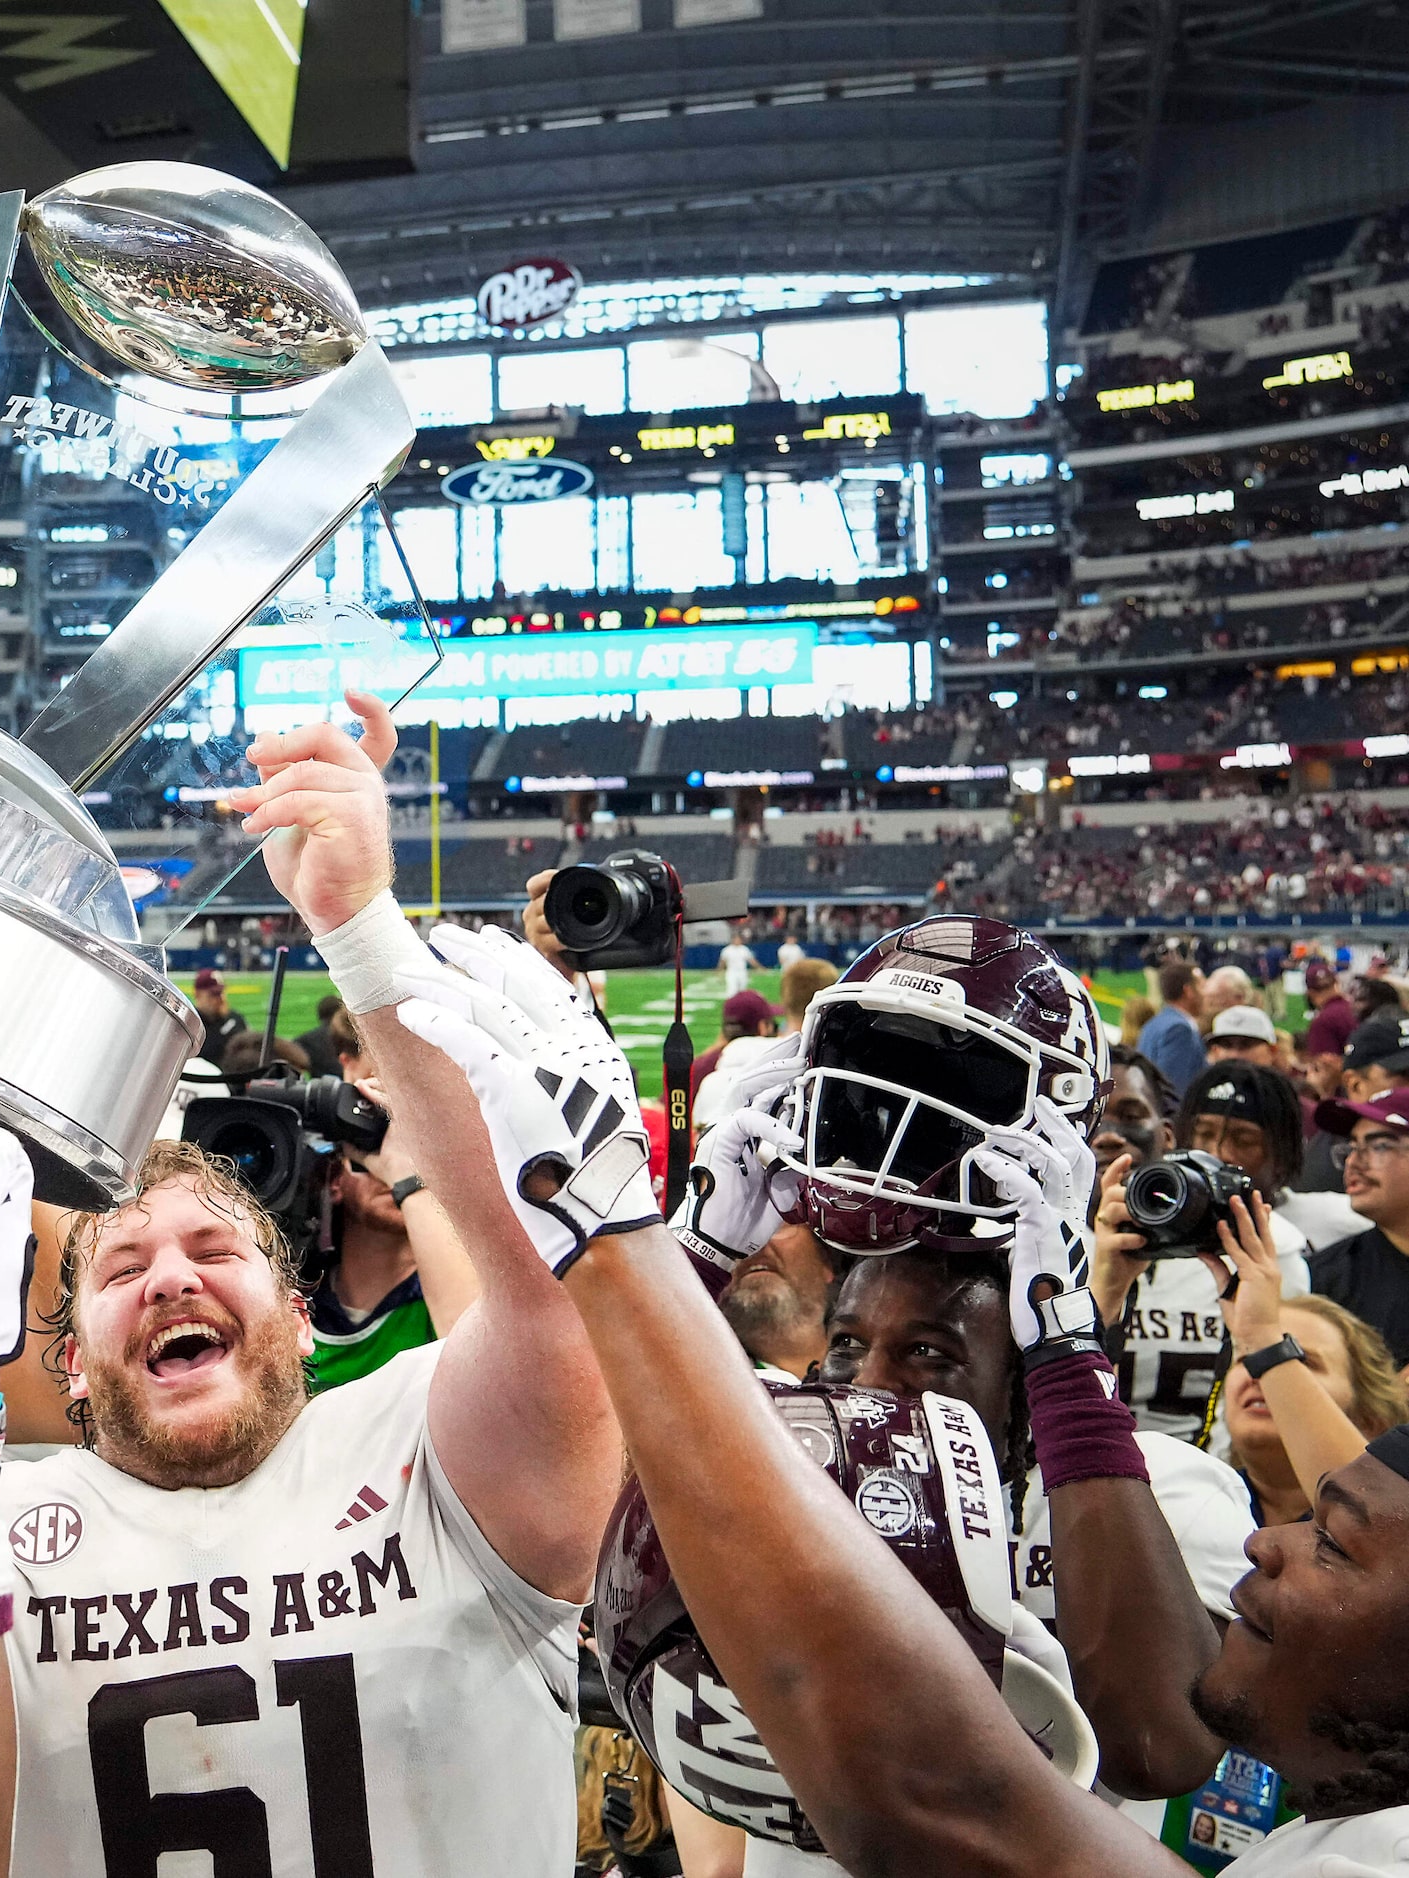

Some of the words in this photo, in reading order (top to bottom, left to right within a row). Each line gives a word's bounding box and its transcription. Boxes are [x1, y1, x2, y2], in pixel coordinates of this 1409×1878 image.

[514, 264, 555, 290] Dr
[471, 466, 565, 501] Ford
[492, 650, 599, 681] POWERED
[604, 649, 633, 678] BY
[636, 641, 733, 678] AT&T
[733, 638, 798, 675] 5G
[889, 972, 944, 996] AGGIES
[671, 1088, 687, 1130] EOS
[700, 1246, 716, 1260] GIG
[936, 1401, 973, 1438] A&M
[892, 1434, 929, 1473] 24
[862, 1481, 910, 1532] SEC
[949, 1439, 992, 1540] TEXAS
[10, 1504, 82, 1565] SEC
[27, 1576, 250, 1663] TEXAS
[271, 1532, 417, 1637] A&M
[88, 1653, 376, 1878] 61
